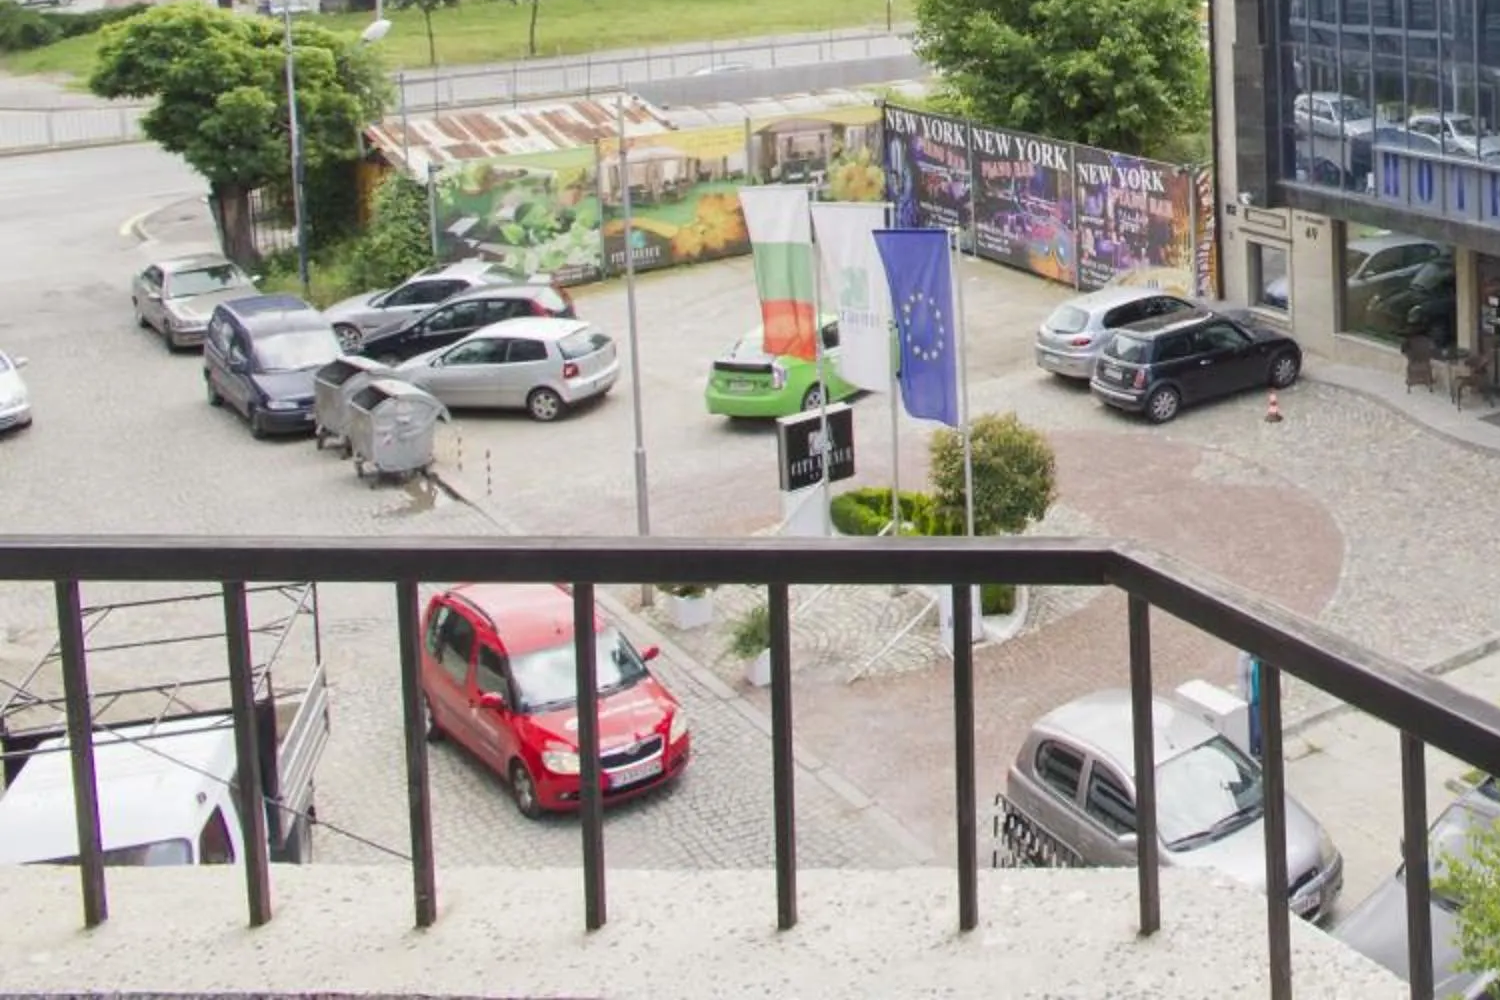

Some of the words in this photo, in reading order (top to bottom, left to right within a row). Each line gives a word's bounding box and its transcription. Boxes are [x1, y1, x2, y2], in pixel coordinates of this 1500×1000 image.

[885, 107, 917, 135] NEW
[920, 115, 967, 148] YORK
[972, 127, 1011, 158] NEW
[1015, 136, 1069, 171] YORK
[1076, 162, 1112, 184] NEW
[1115, 166, 1164, 192] YORK
